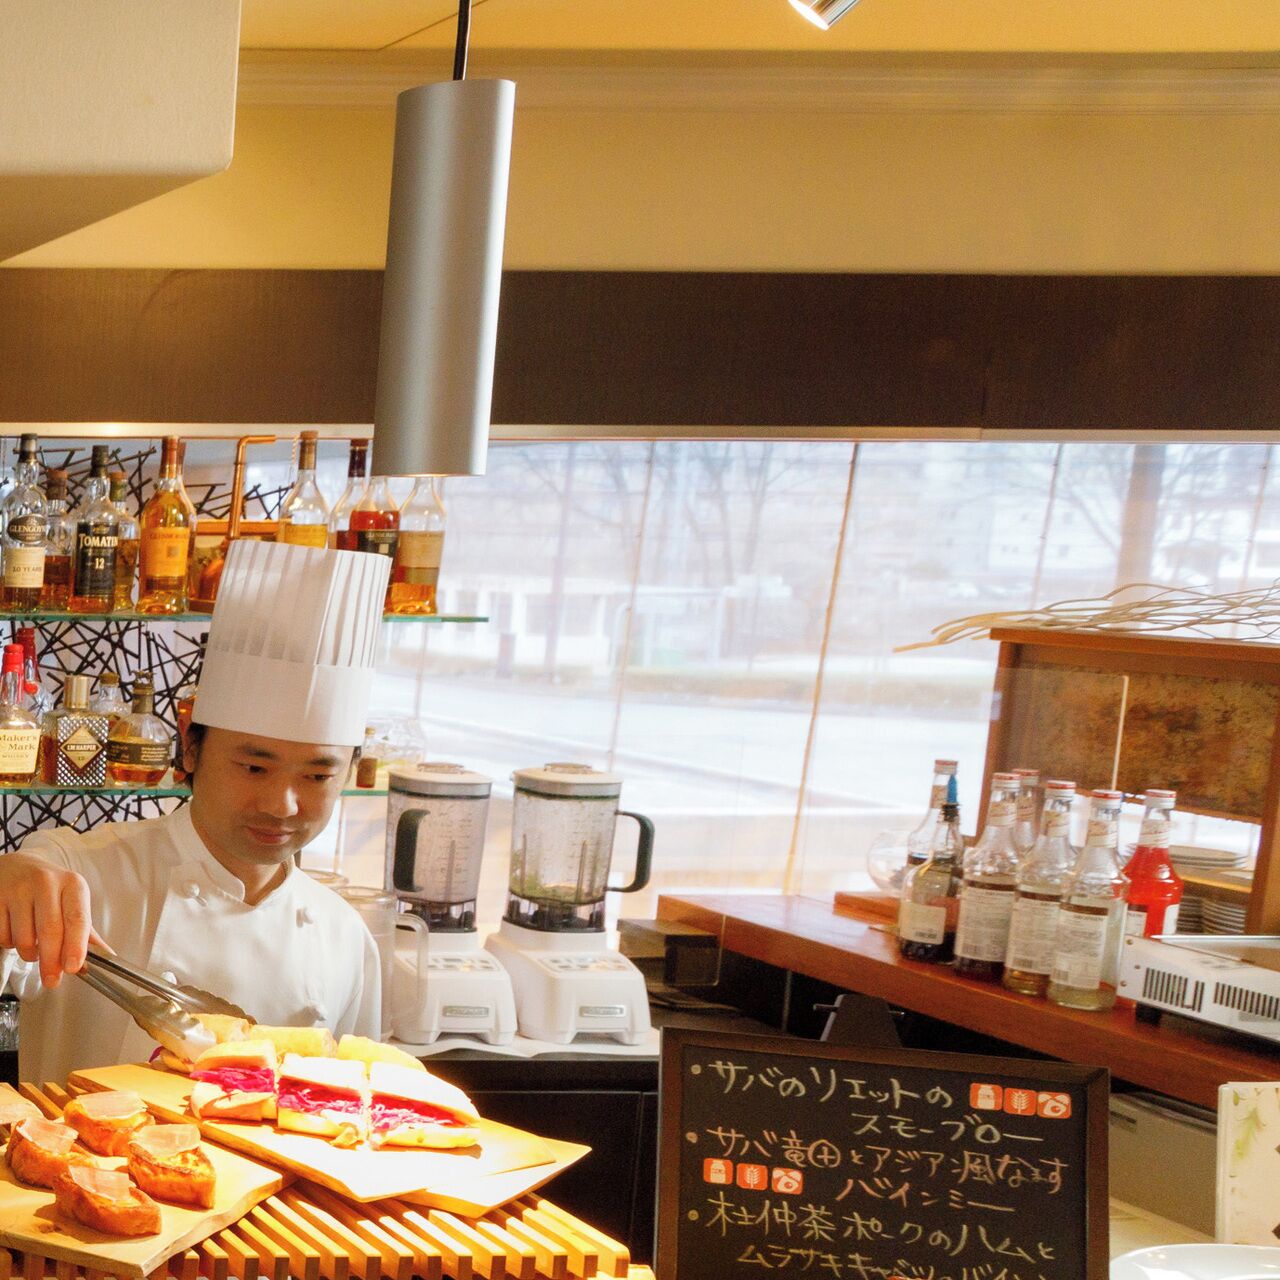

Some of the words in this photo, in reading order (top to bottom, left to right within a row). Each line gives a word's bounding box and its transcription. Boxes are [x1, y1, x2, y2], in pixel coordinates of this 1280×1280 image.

[95, 557, 105, 569] 12
[708, 1060, 954, 1111] サバのリエットの
